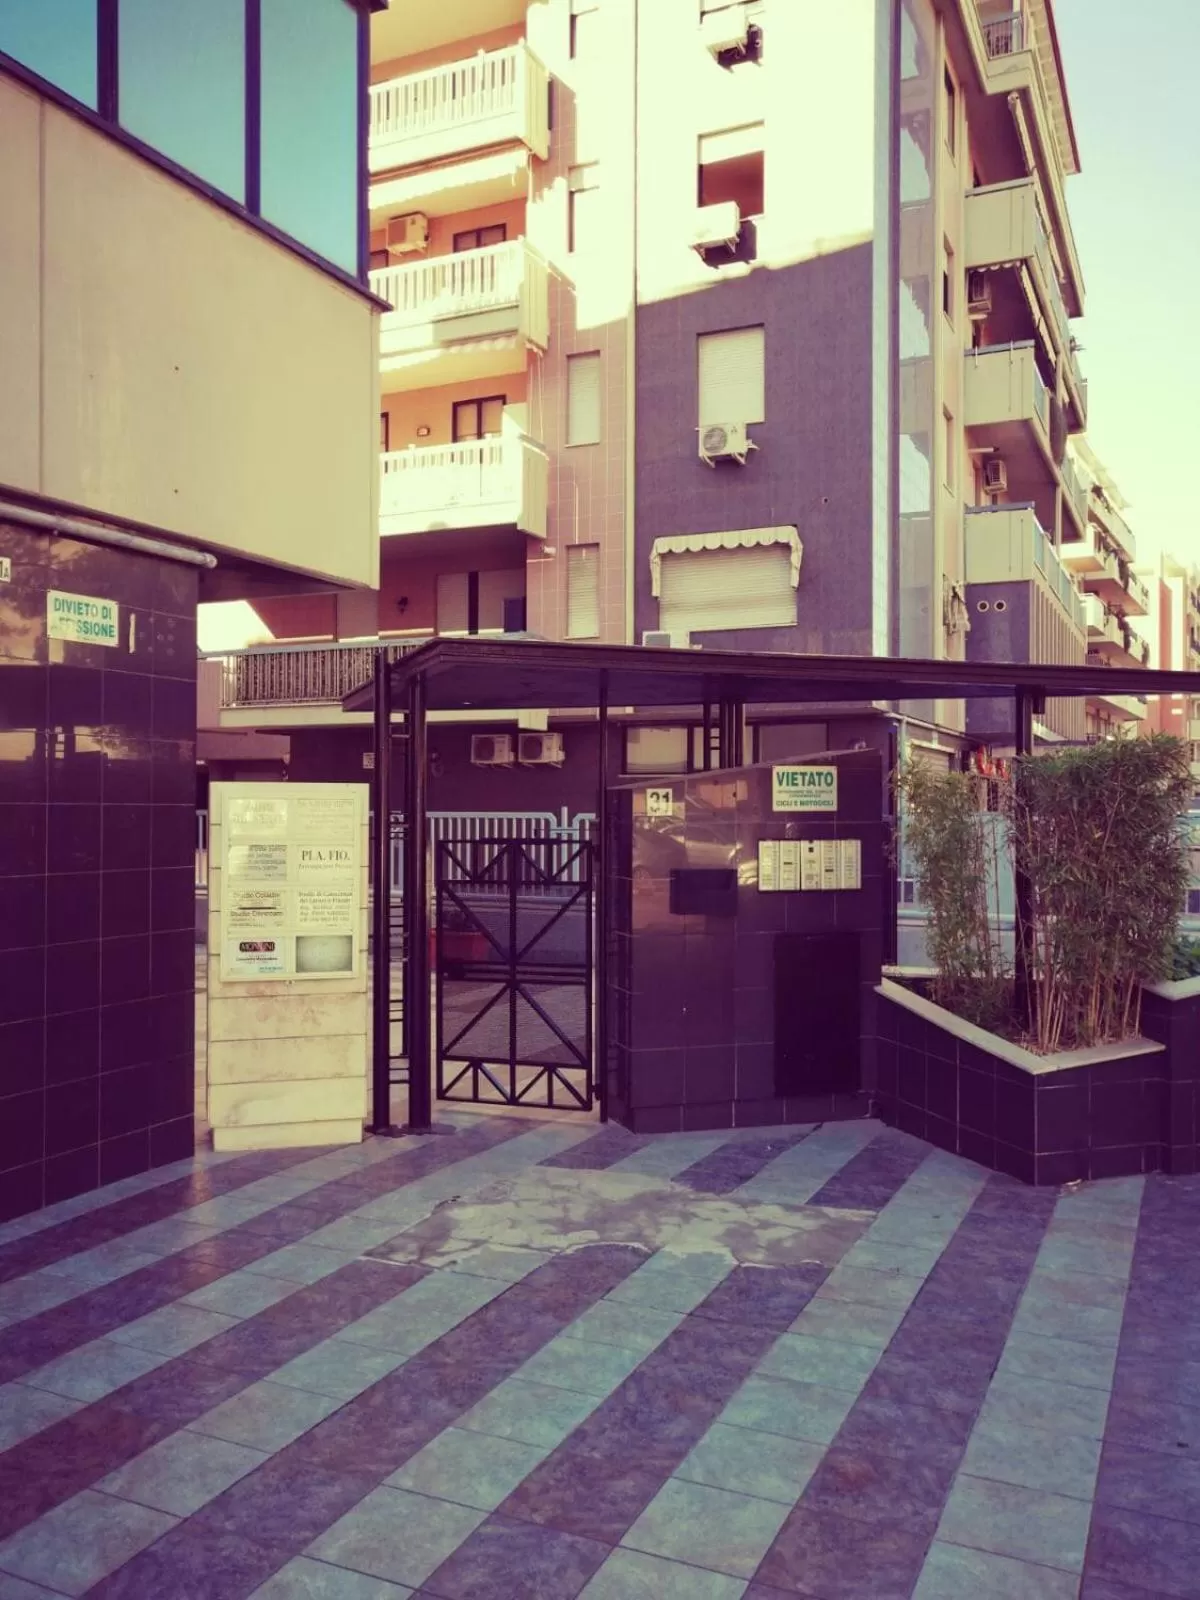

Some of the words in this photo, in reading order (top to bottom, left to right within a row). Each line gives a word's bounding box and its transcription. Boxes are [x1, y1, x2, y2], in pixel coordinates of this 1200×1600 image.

[53, 597, 99, 617] DIVIETO
[101, 605, 112, 620] DI
[54, 617, 115, 637] SSIONE
[776, 771, 834, 787] VIETATO
[650, 791, 670, 813] 31
